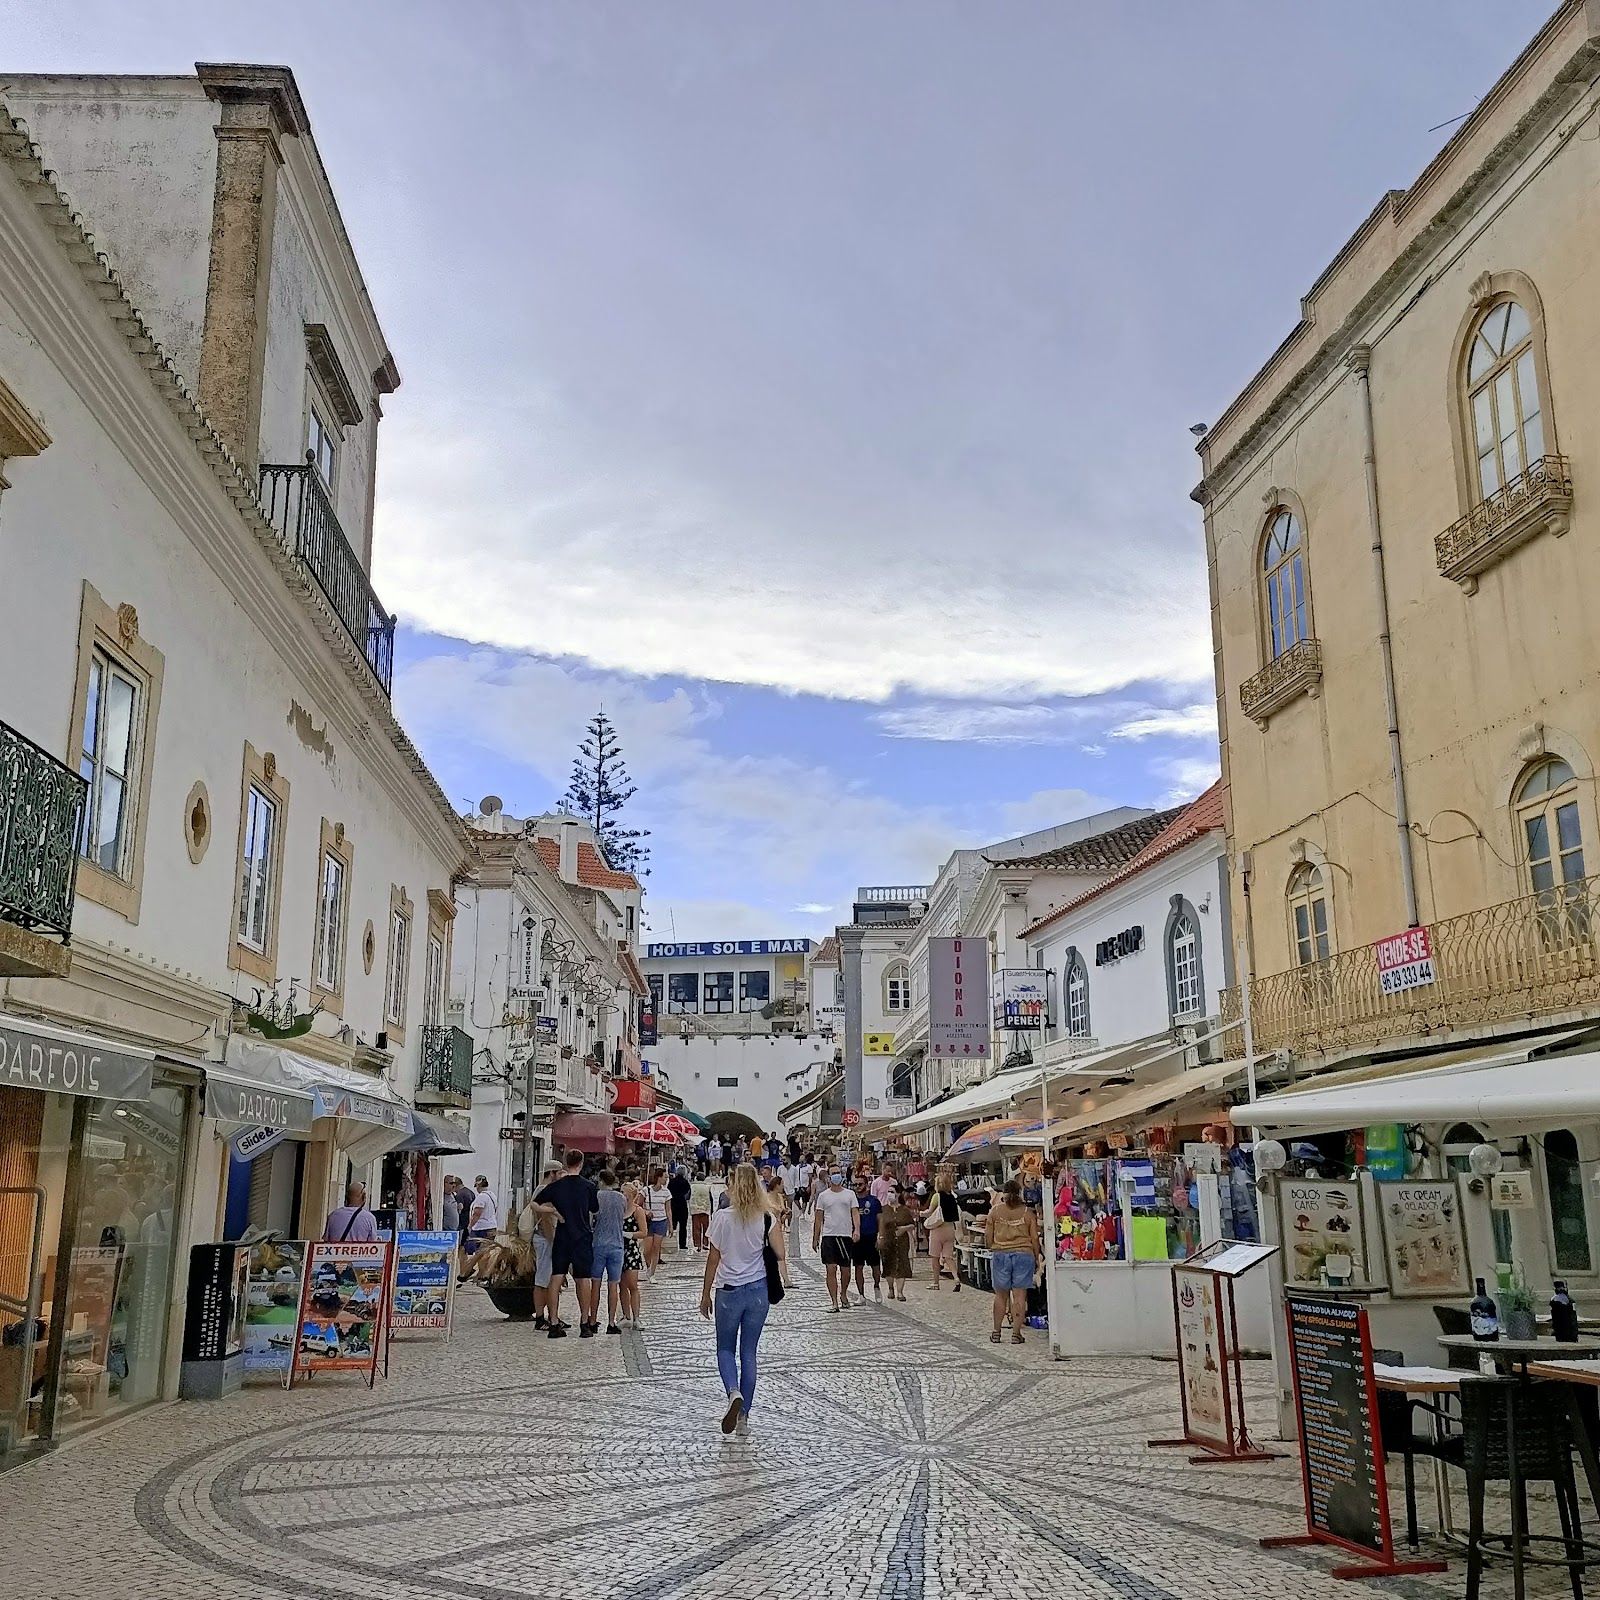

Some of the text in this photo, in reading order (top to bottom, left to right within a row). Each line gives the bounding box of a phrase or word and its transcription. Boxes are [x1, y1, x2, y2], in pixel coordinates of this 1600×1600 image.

[652, 940, 805, 957] HOTEL SOL E MAR
[1096, 926, 1142, 966] ALE-HOP
[1377, 931, 1427, 968] VENDE-SE
[954, 940, 963, 1017] DIONA
[1382, 961, 1432, 991] 96 29 333 44
[511, 987, 544, 998] Atrium
[238, 1091, 289, 1125] PARFOIS
[241, 1126, 280, 1150] slide&
[1291, 1188, 1320, 1200] BOLOS
[1413, 1190, 1442, 1201] CREAM
[1294, 1200, 1319, 1211] CAKES
[316, 1245, 379, 1256] EXTREMO
[390, 1316, 412, 1328] BOOK
